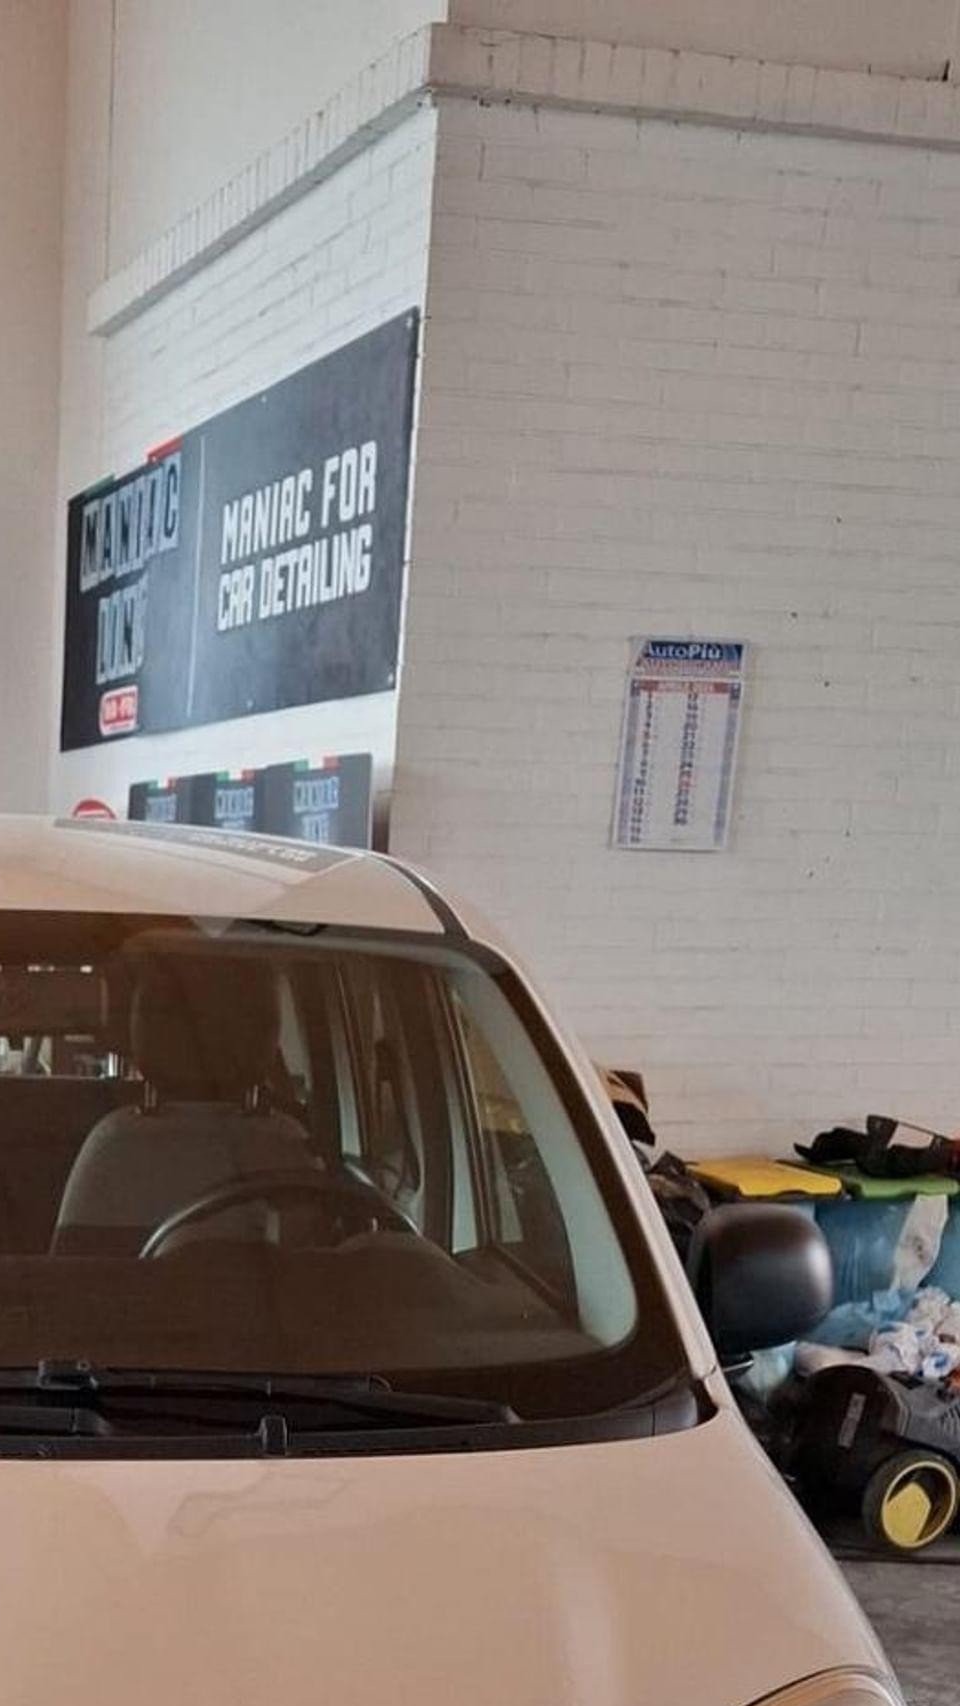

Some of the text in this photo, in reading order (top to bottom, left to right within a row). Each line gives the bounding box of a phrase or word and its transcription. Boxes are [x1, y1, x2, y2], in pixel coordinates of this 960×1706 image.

[221, 440, 377, 565] MANIAC FOR
[218, 524, 372, 631] CAR DETAILING
